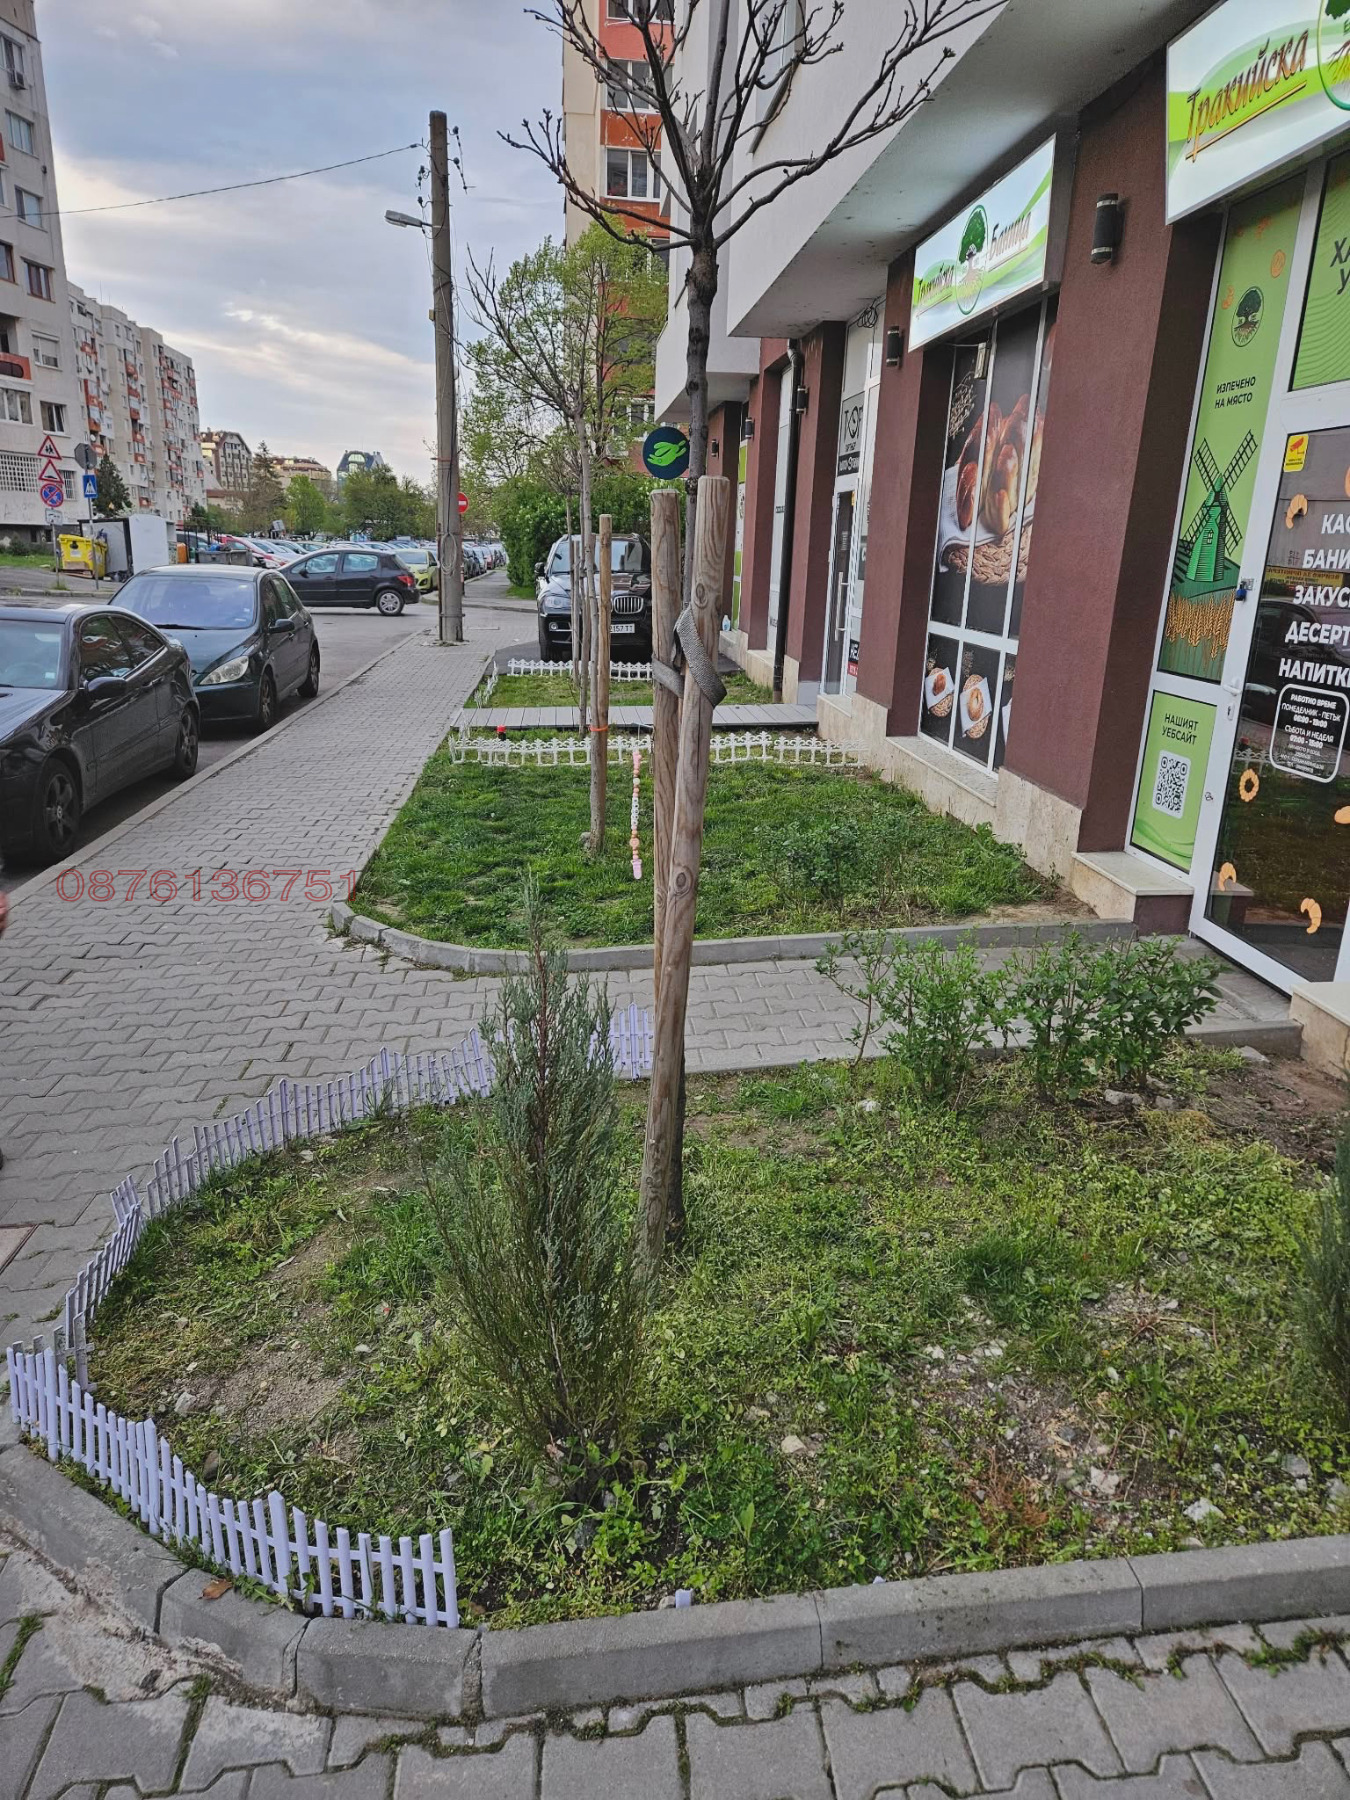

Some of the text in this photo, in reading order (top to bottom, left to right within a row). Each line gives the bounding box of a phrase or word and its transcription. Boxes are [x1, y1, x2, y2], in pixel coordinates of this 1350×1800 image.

[1187, 28, 1308, 163] Тракийска
[1216, 376, 1256, 394] ИЗПЕЧЕНО
[1215, 392, 1253, 409] НА МЯСТО
[1293, 585, 1350, 608] ЗАКУС
[1290, 694, 1337, 710] РАБОТНО ВРЕМЕ
[1281, 702, 1318, 717] ПОНЕДЕЛНИК
[1321, 711, 1341, 722] ПЕТЪК
[1164, 713, 1199, 731] НАШИЯТ
[1162, 725, 1197, 745] УЕБСАЙТ
[1284, 725, 1306, 737] СЪБОТА
[1311, 731, 1334, 743] НЕДЕЛЯ
